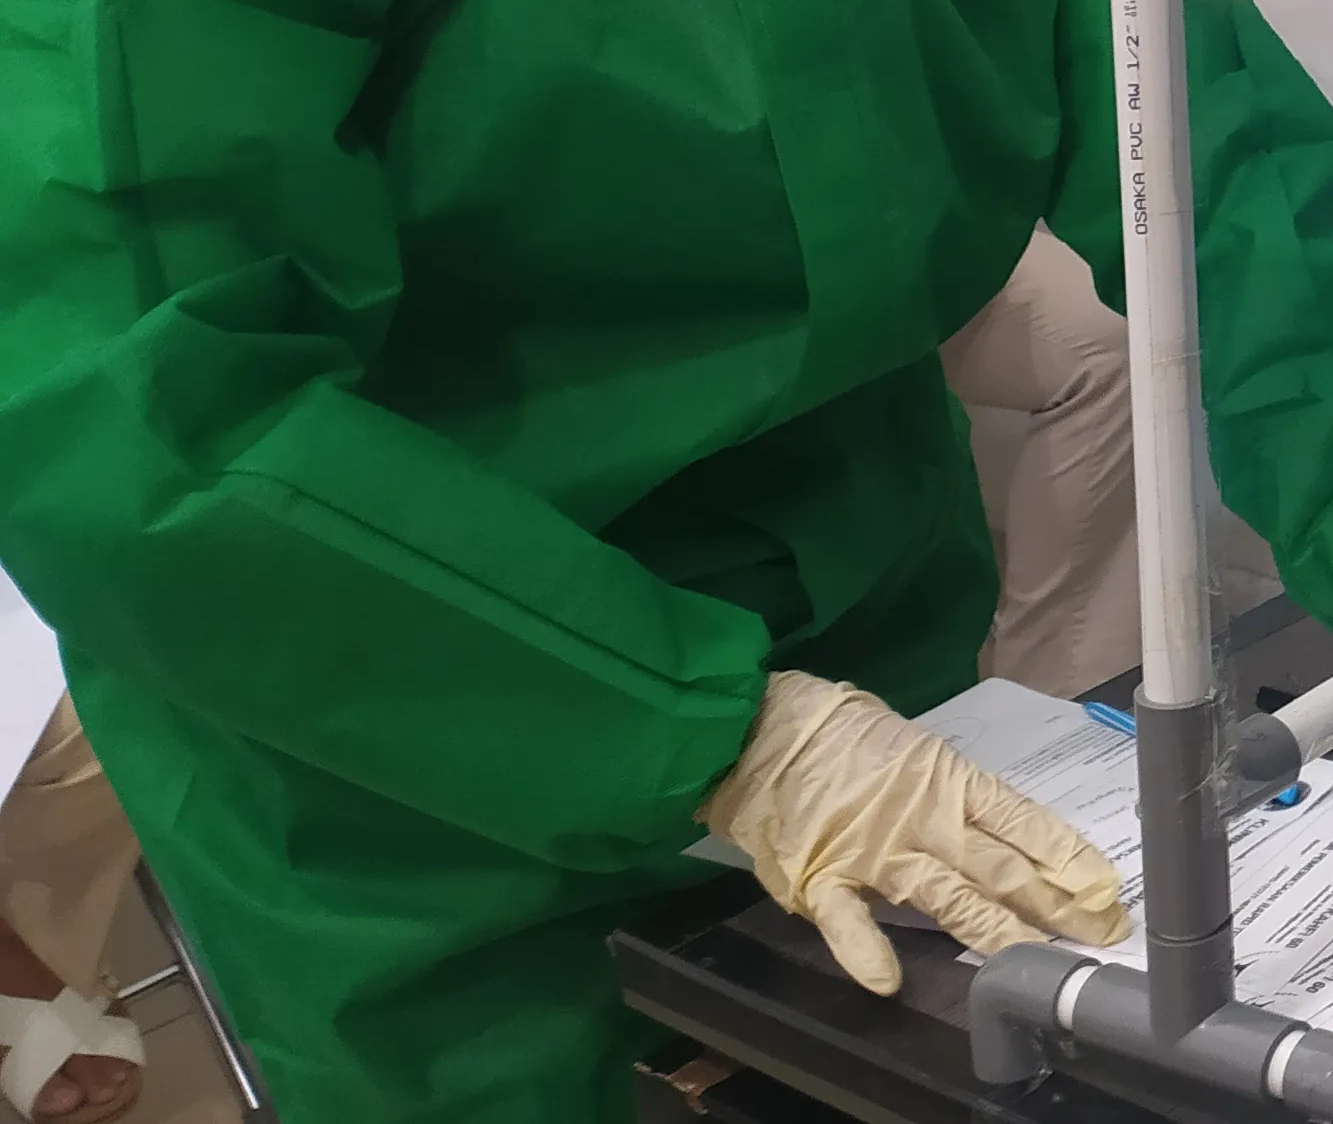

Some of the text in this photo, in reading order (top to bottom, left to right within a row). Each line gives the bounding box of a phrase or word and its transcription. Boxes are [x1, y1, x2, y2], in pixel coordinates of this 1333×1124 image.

[1128, 82, 1142, 111] AW
[1130, 121, 1145, 162] PVC
[1133, 172, 1148, 236] OSAKA
[1304, 979, 1327, 997] 60
